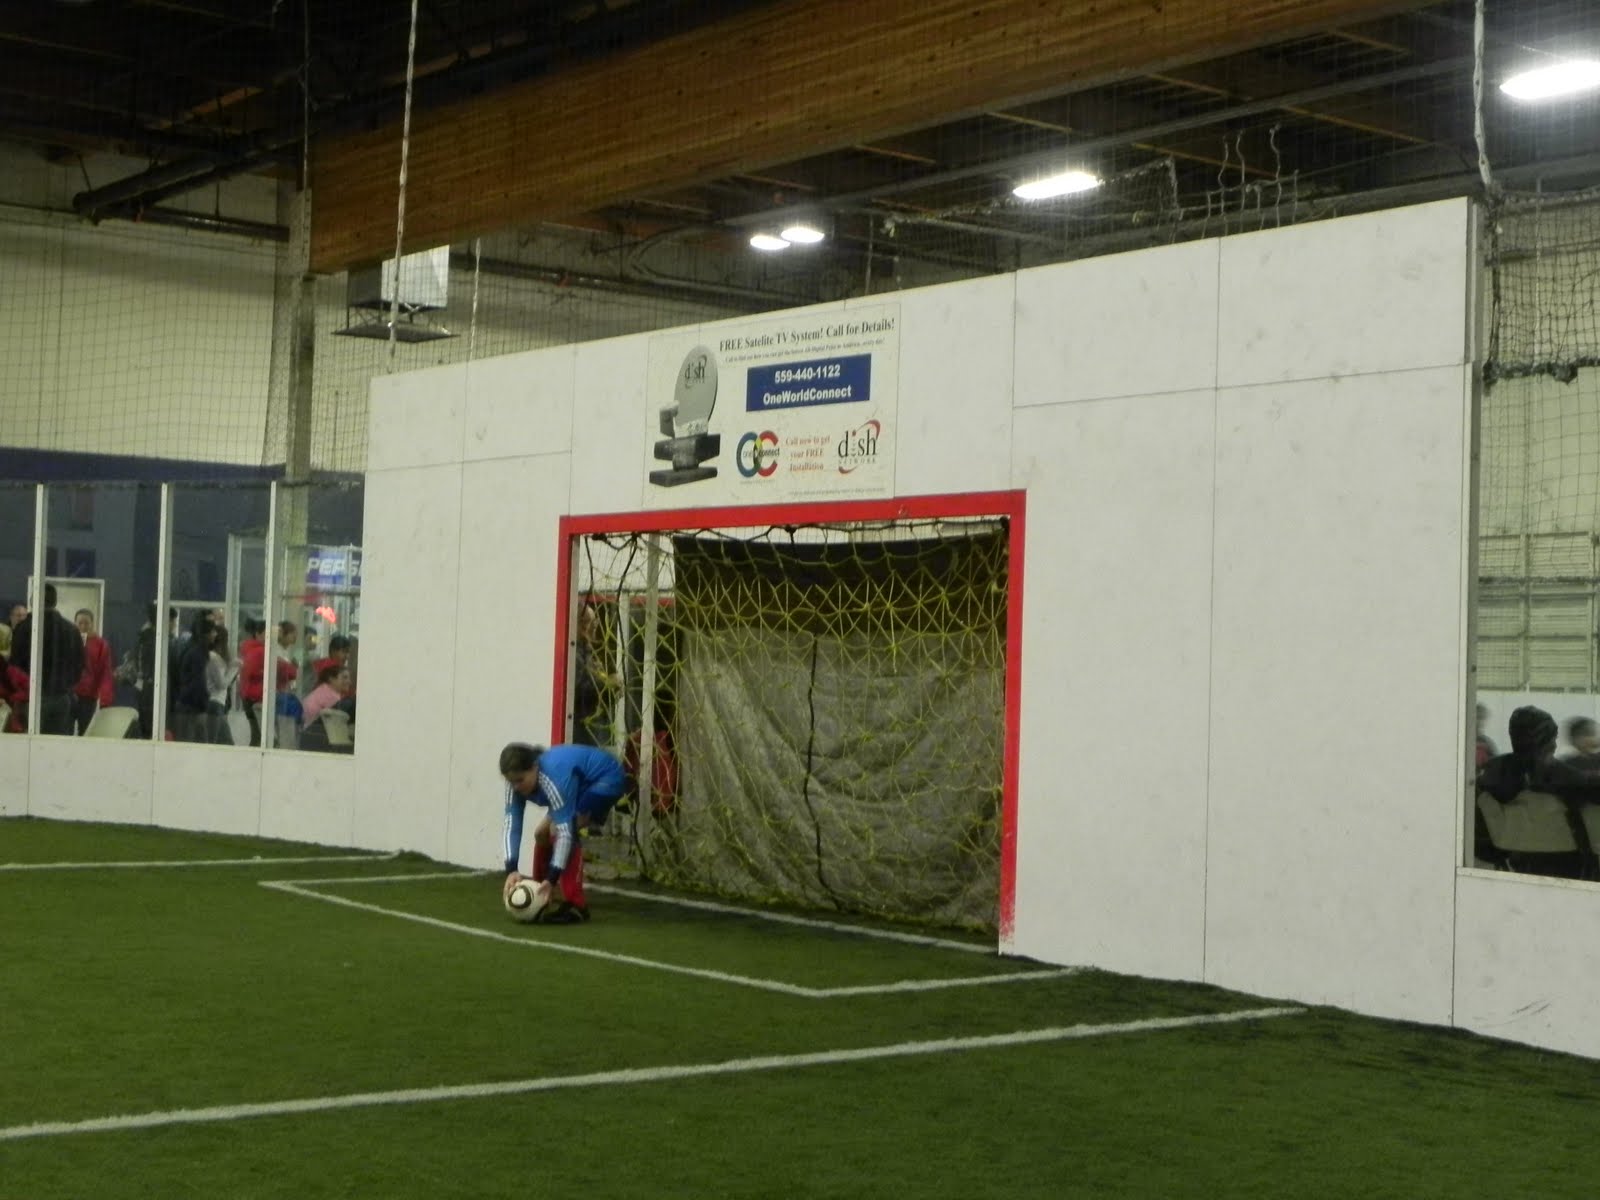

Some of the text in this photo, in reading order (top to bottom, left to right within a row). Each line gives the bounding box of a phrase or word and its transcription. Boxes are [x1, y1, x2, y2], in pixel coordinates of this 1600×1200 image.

[720, 338, 743, 351] FREE
[745, 333, 774, 348] Satelite
[777, 331, 789, 344] TV
[791, 326, 823, 344] System!
[826, 323, 844, 337] Call
[846, 322, 859, 335] for
[862, 317, 895, 333] Details!
[774, 364, 841, 384] 559-440-1122
[763, 385, 852, 405] OneWorldConnect
[805, 447, 824, 458] FREE
[838, 428, 877, 458] dish
